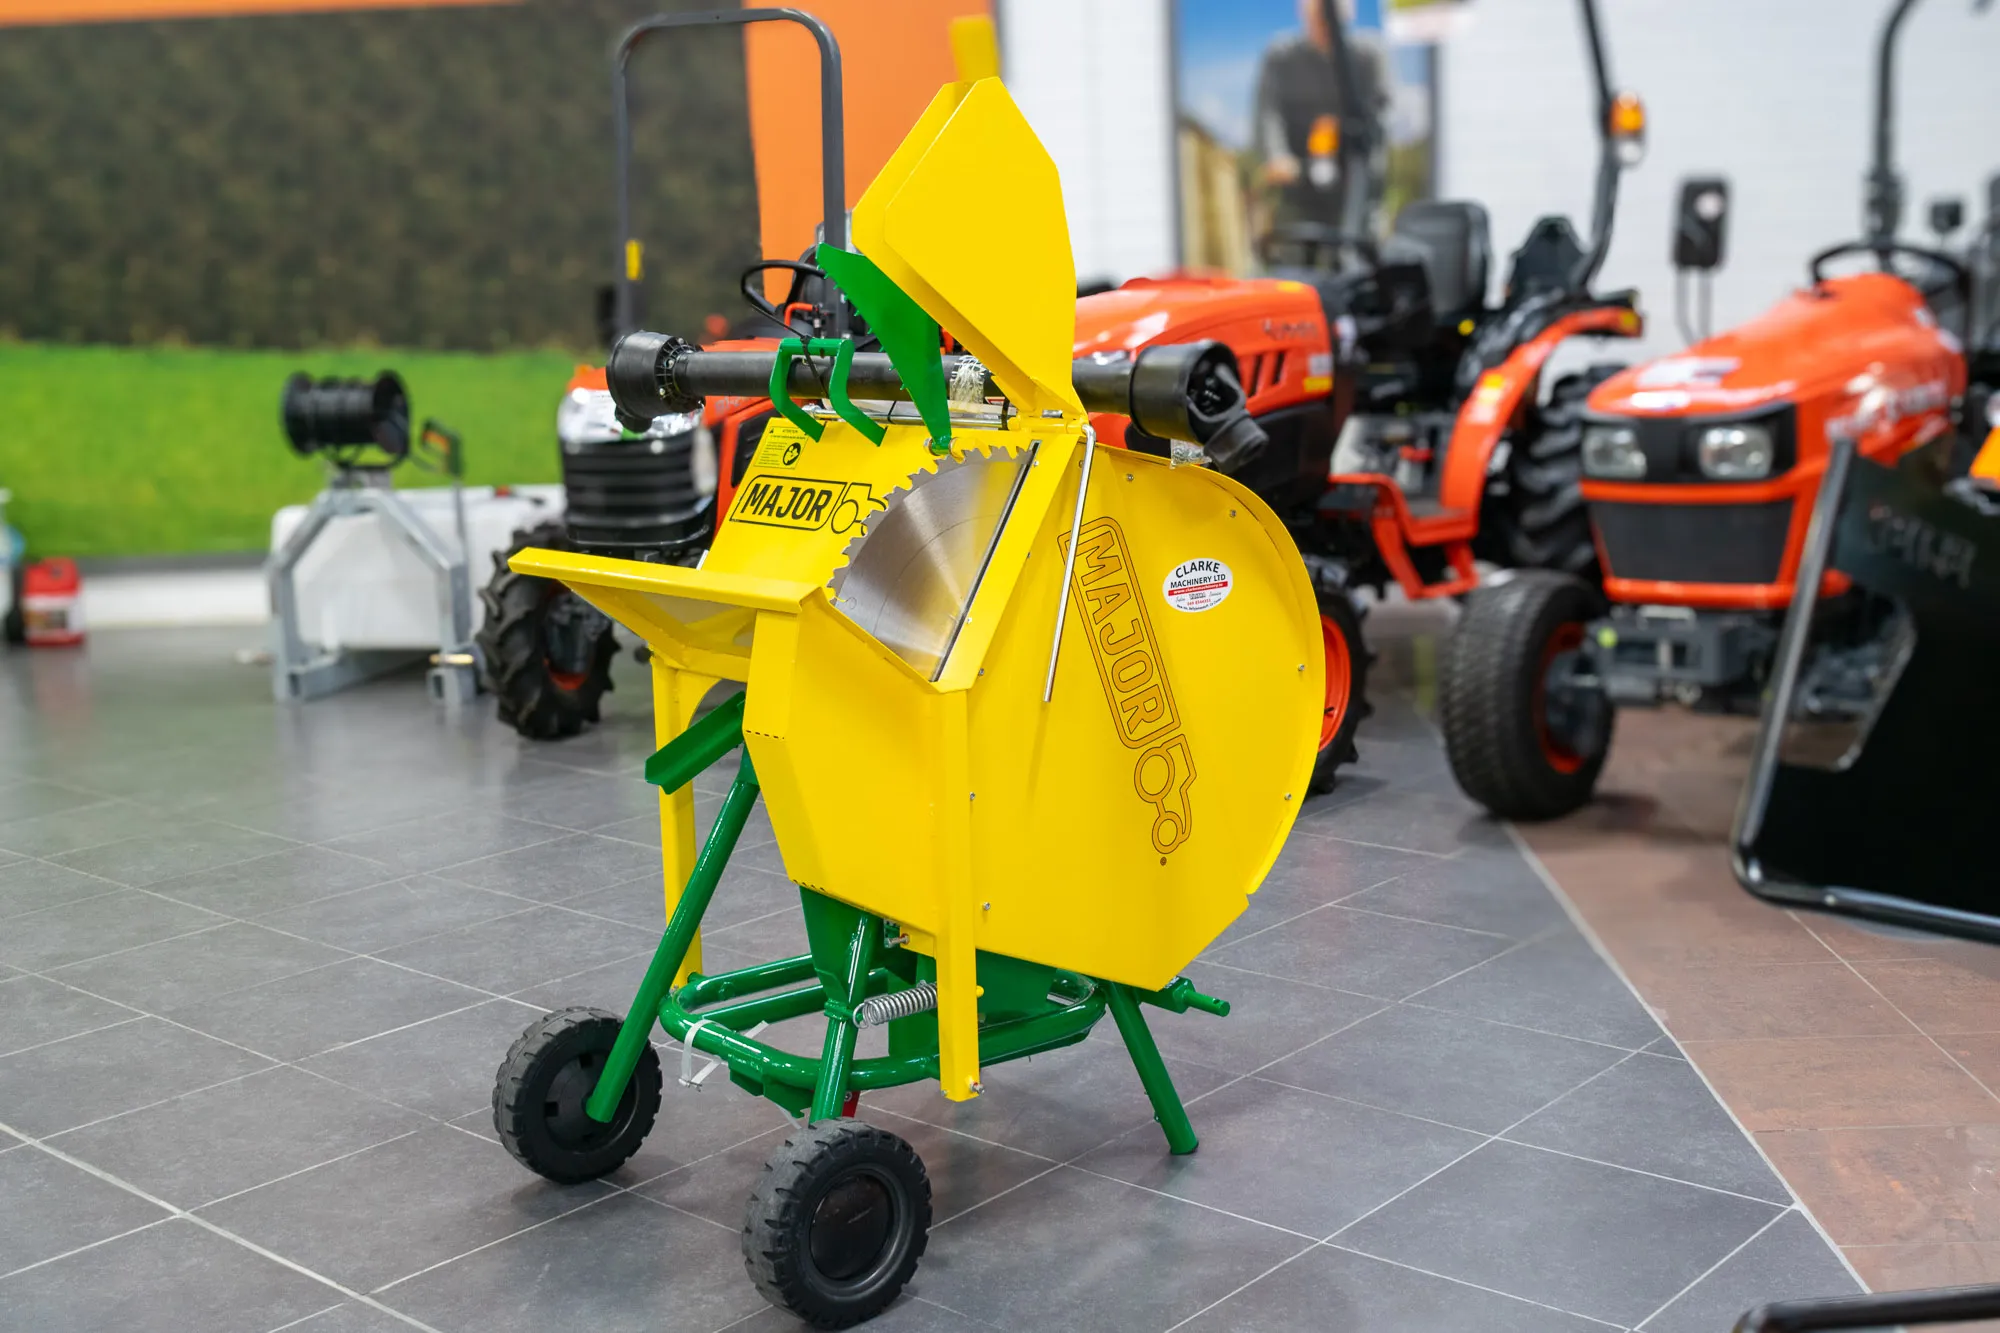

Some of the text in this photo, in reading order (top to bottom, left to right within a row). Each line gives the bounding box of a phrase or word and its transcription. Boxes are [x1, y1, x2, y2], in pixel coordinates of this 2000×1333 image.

[740, 483, 833, 522] MAJOR
[1170, 573, 1226, 589] MACHINERY LTD
[1175, 560, 1220, 578] CLARKE
[1075, 531, 1165, 735] MAJOR
